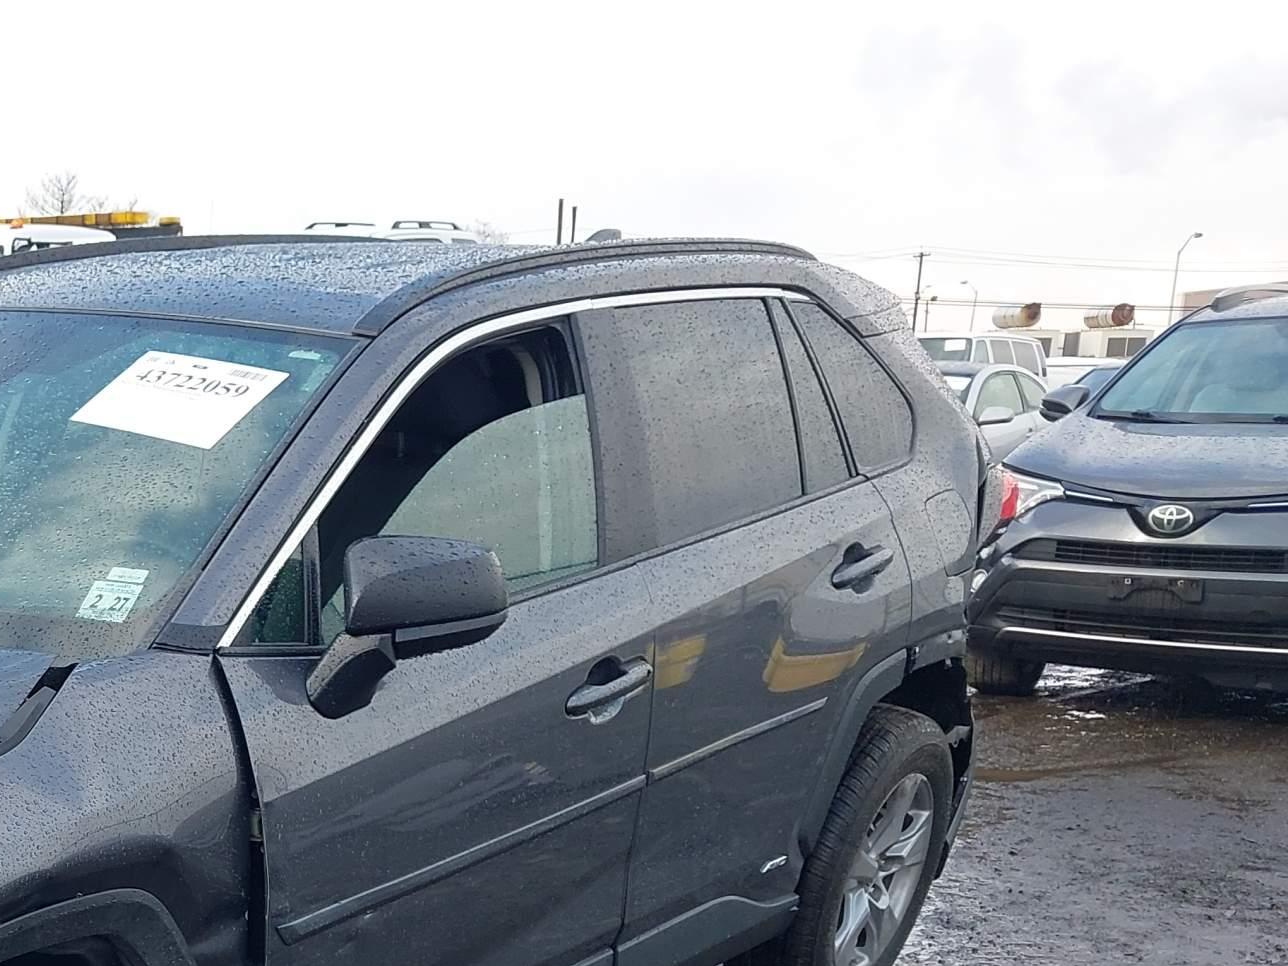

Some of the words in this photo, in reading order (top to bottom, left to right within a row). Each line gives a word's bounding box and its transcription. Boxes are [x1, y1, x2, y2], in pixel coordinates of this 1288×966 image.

[135, 368, 251, 398] 43722059
[89, 594, 103, 608] 2
[107, 596, 131, 611] 27
